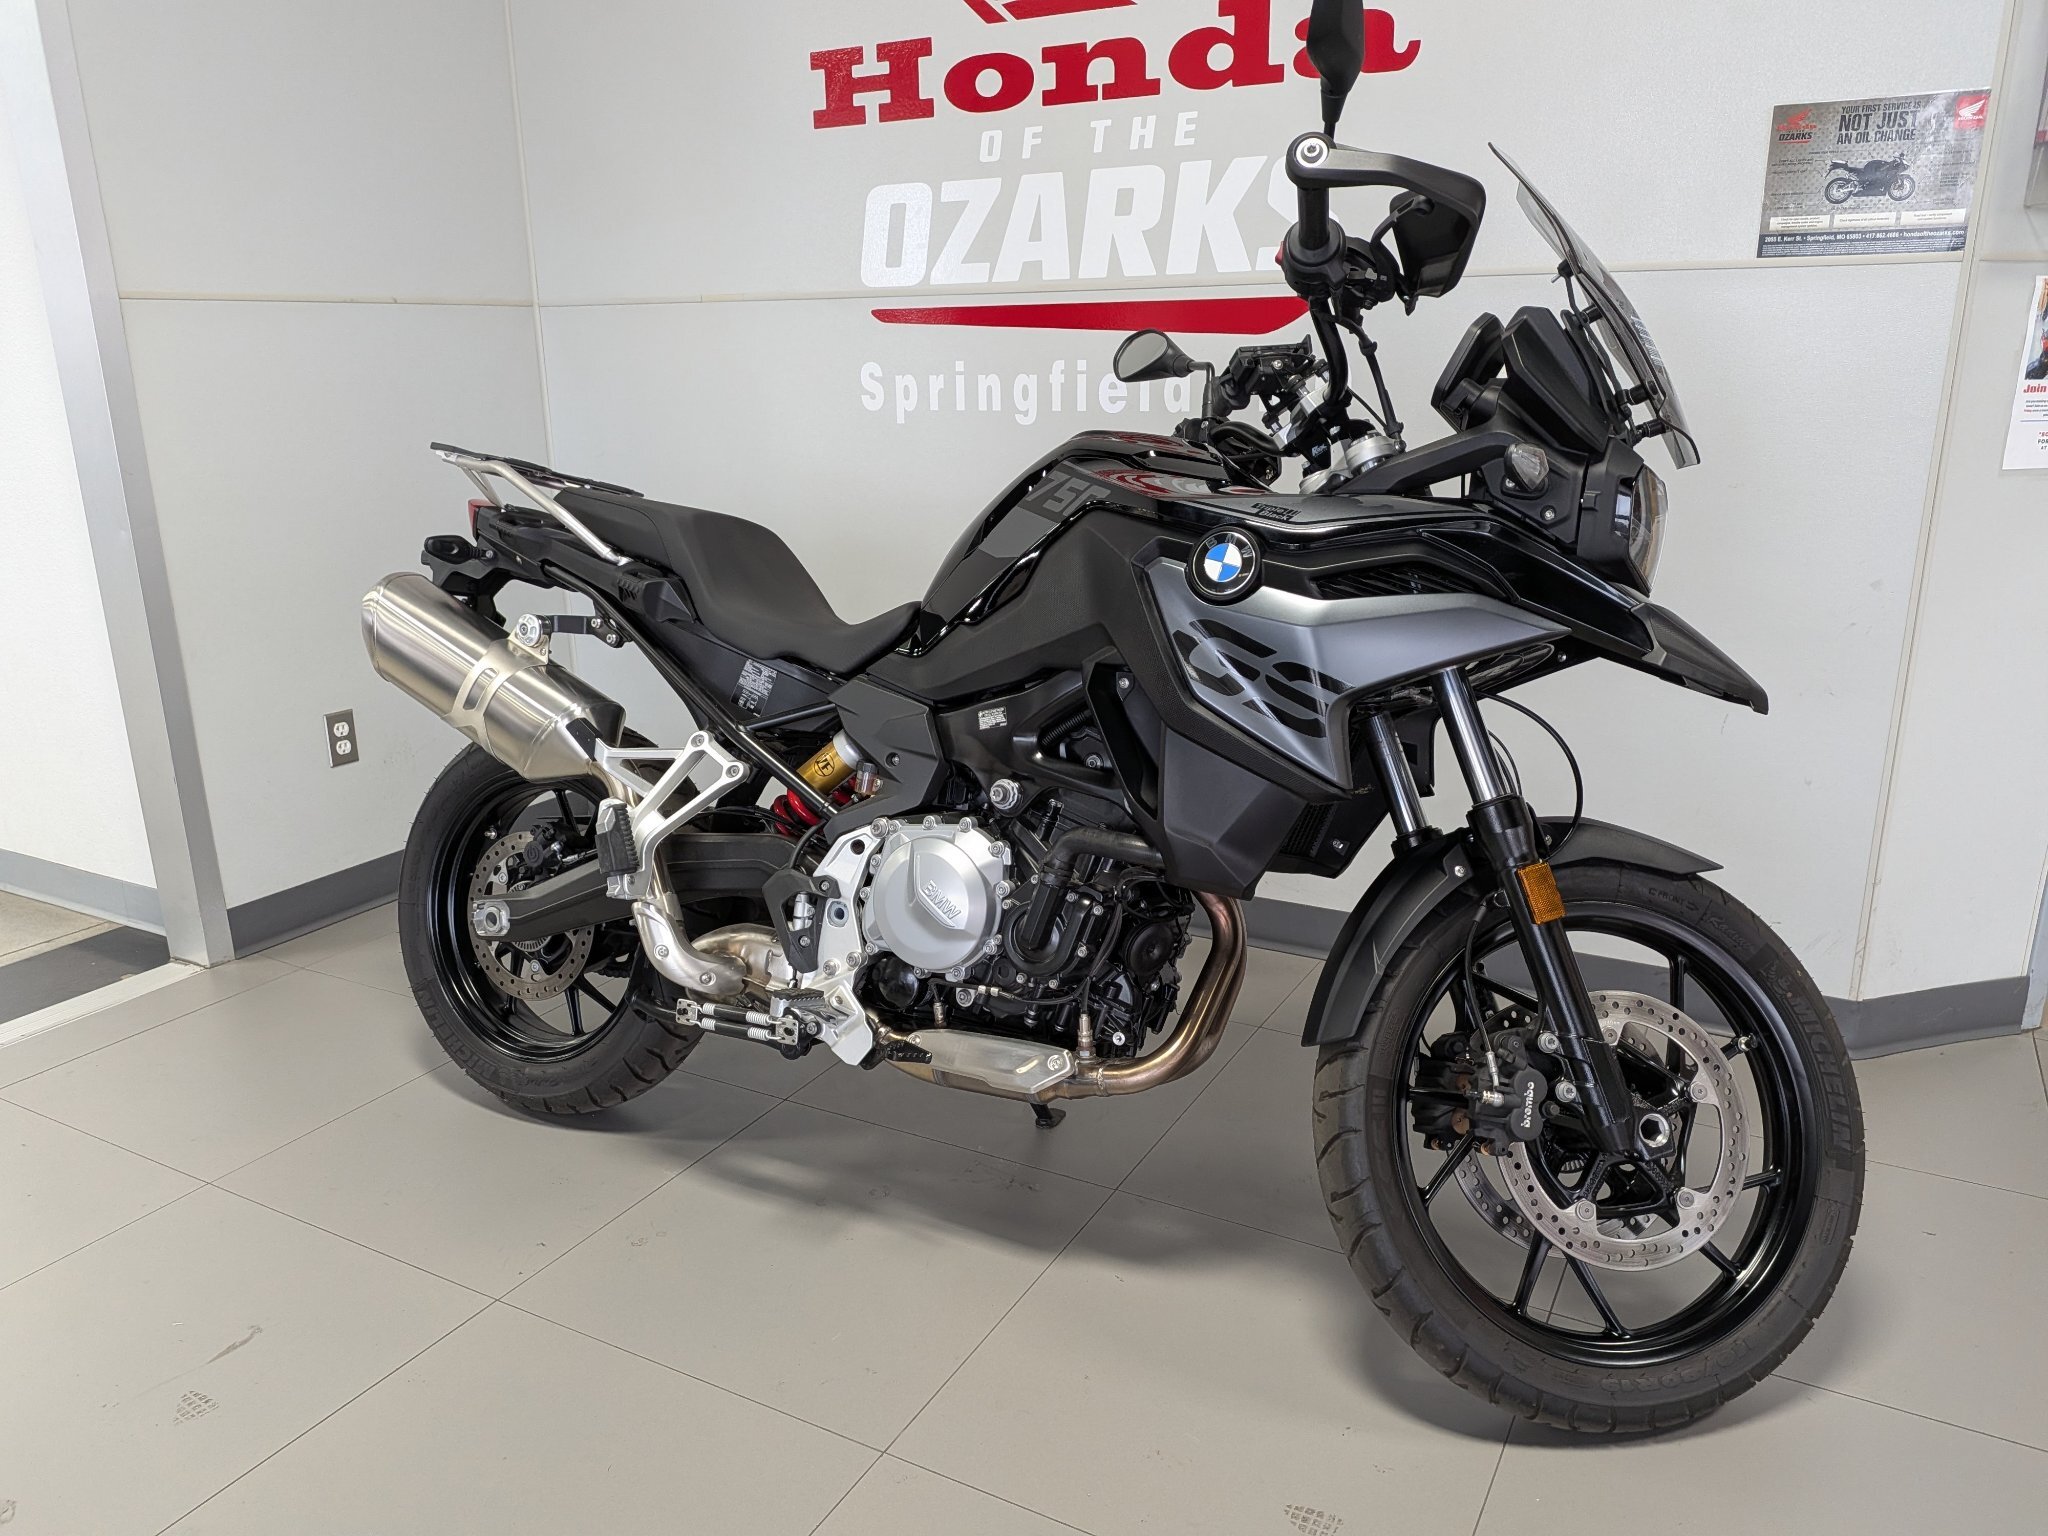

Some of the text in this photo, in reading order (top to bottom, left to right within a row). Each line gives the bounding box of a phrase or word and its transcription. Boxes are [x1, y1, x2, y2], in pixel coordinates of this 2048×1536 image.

[810, 0, 1421, 129] Honda
[1839, 113, 1872, 131] NOT
[1877, 110, 1920, 129] JUST
[1841, 101, 1921, 114] YOUR FIRST SERVICE IS
[979, 111, 1198, 163] OF THE
[1779, 132, 1812, 141] OZARKS
[1836, 129, 1916, 144] AN OIL CHANGE
[860, 359, 1191, 425] Springfield
[2023, 384, 2047, 393] Join
[1205, 533, 1253, 558] BMW
[921, 879, 962, 920] BMW
[1792, 994, 1853, 1153] MICHELIN
[1520, 1081, 1535, 1128] brembo
